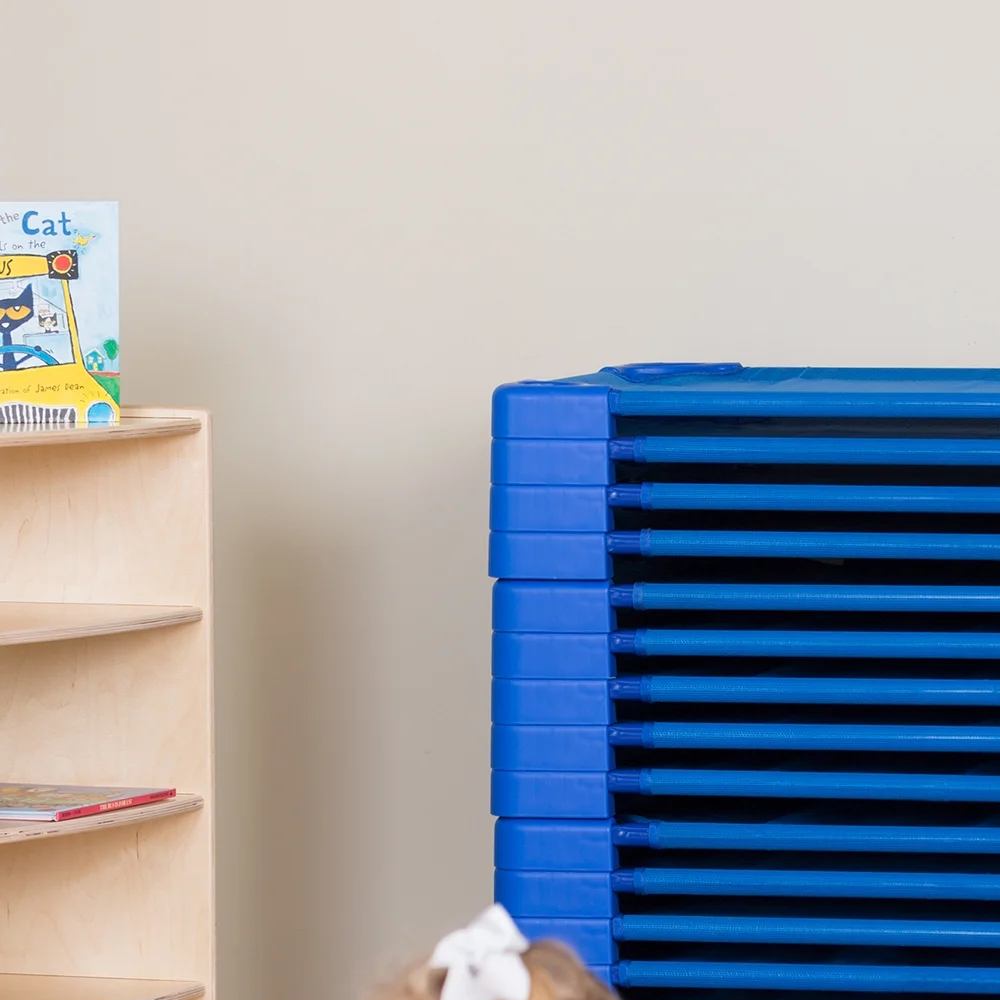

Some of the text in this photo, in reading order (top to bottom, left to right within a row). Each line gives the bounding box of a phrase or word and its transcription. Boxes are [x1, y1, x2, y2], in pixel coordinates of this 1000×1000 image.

[0, 210, 71, 236] the Cat
[28, 240, 46, 249] the
[23, 385, 31, 393] of
[35, 384, 60, 393] James
